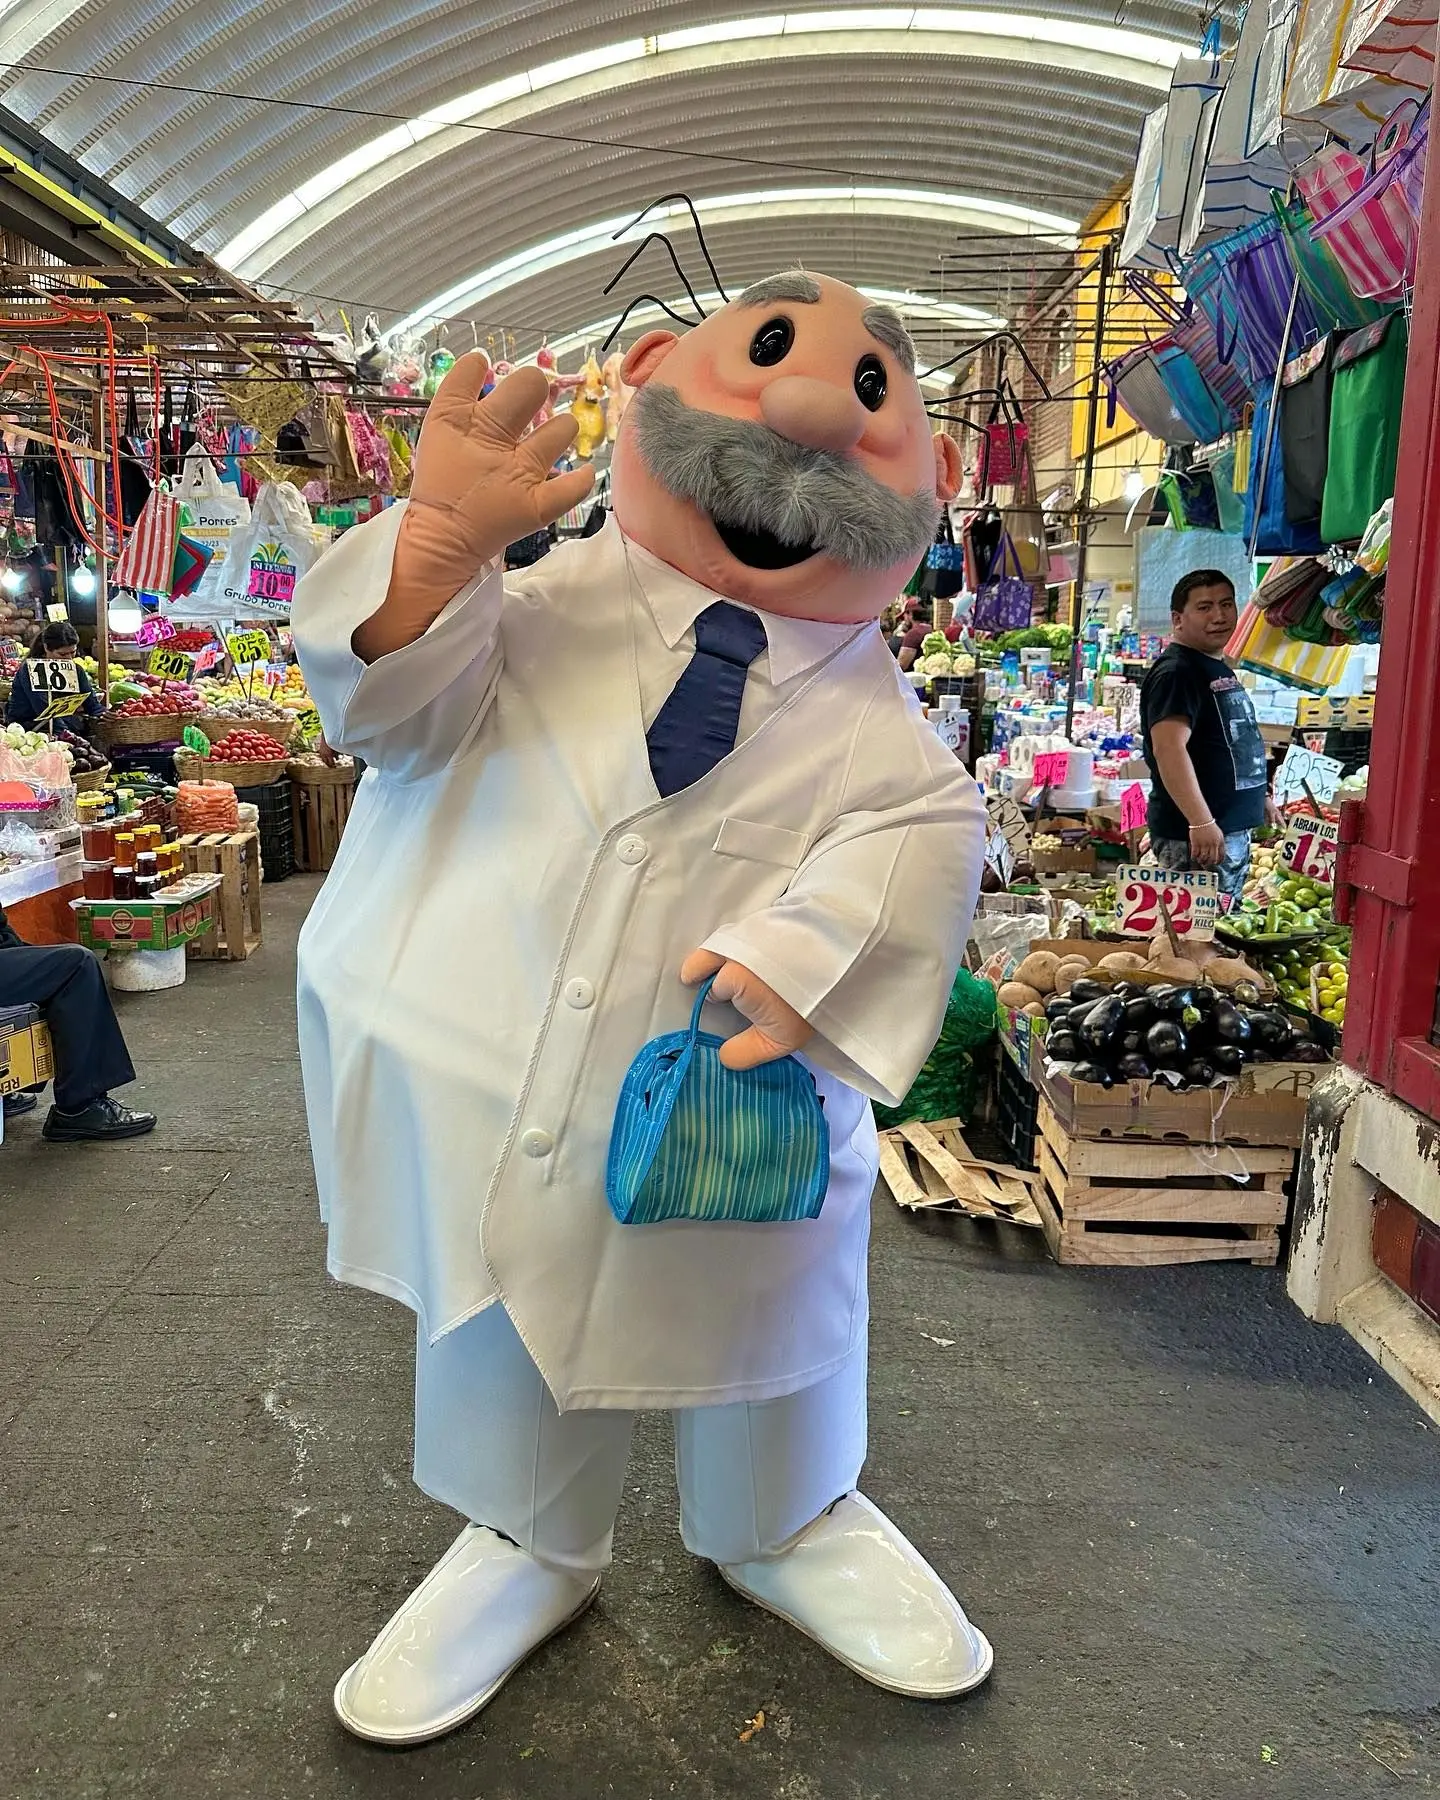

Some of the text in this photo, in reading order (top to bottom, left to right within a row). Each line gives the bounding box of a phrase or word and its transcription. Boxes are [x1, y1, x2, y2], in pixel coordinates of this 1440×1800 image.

[199, 516, 237, 526] Porres
[237, 640, 262, 664] 25
[156, 653, 184, 676] 20
[33, 662, 67, 691] 18
[1292, 817, 1337, 840] ABRAN LOS
[1119, 868, 1218, 887] ¡COMPRE!
[1196, 897, 1216, 908] 00
[1194, 918, 1215, 929] KILO
